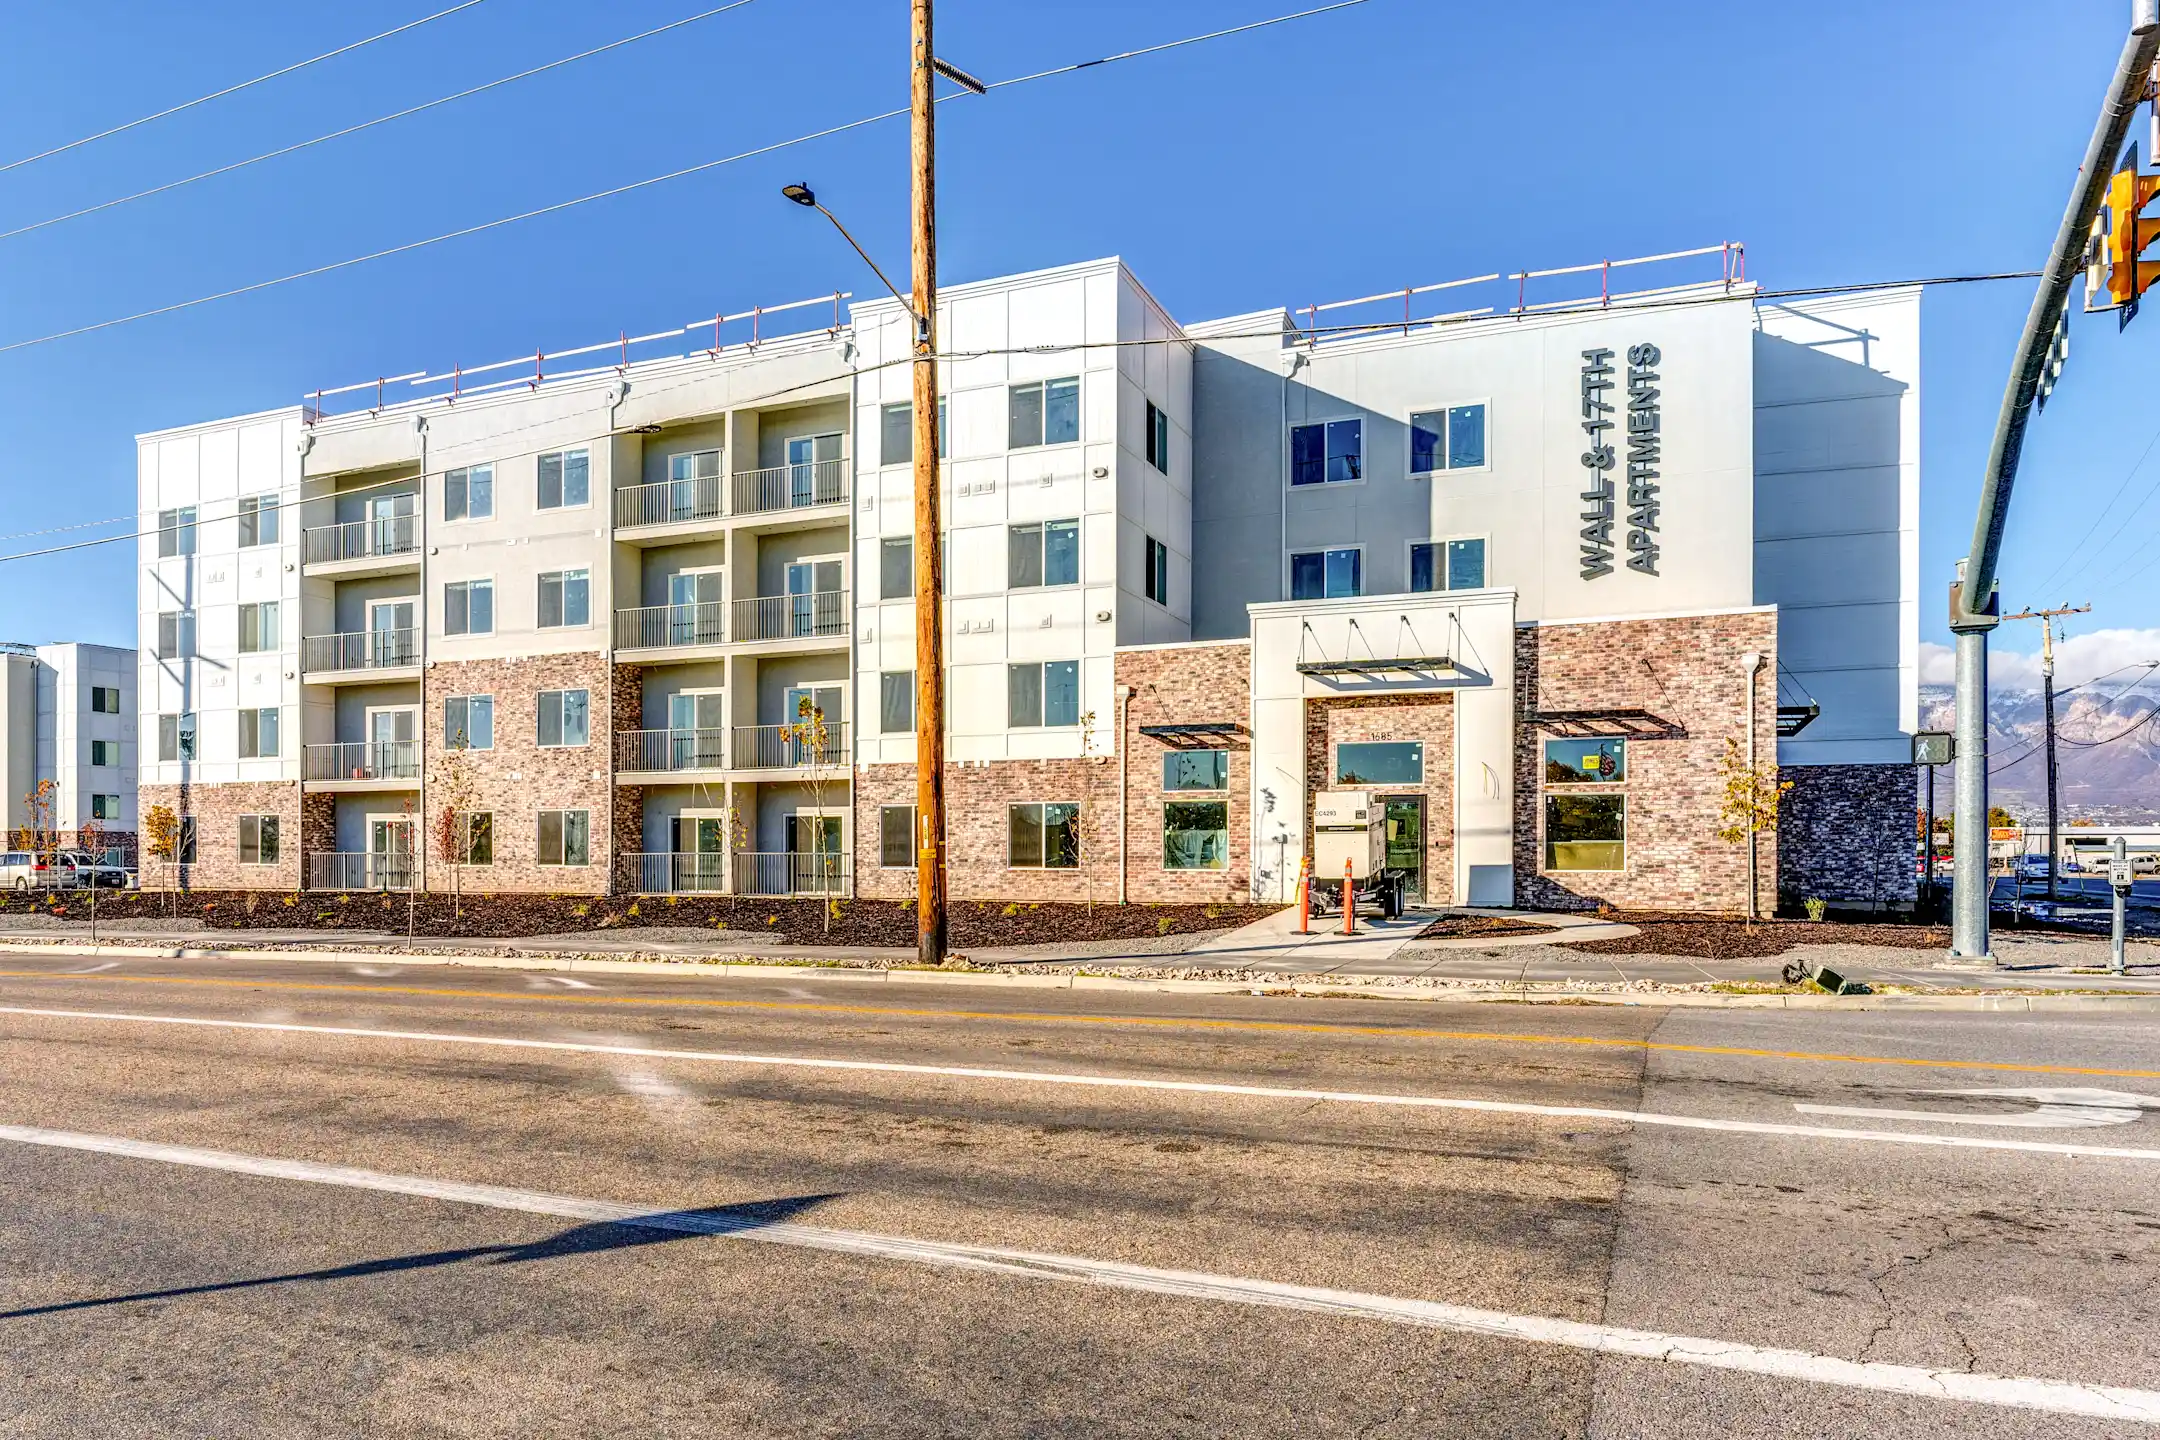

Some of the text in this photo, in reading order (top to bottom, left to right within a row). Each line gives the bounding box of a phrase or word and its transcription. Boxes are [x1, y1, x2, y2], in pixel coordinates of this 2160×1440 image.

[1580, 347, 1611, 580] WALL & 17TH
[1626, 342, 1656, 577] APARTMENTS
[1371, 732, 1393, 741] 1685
